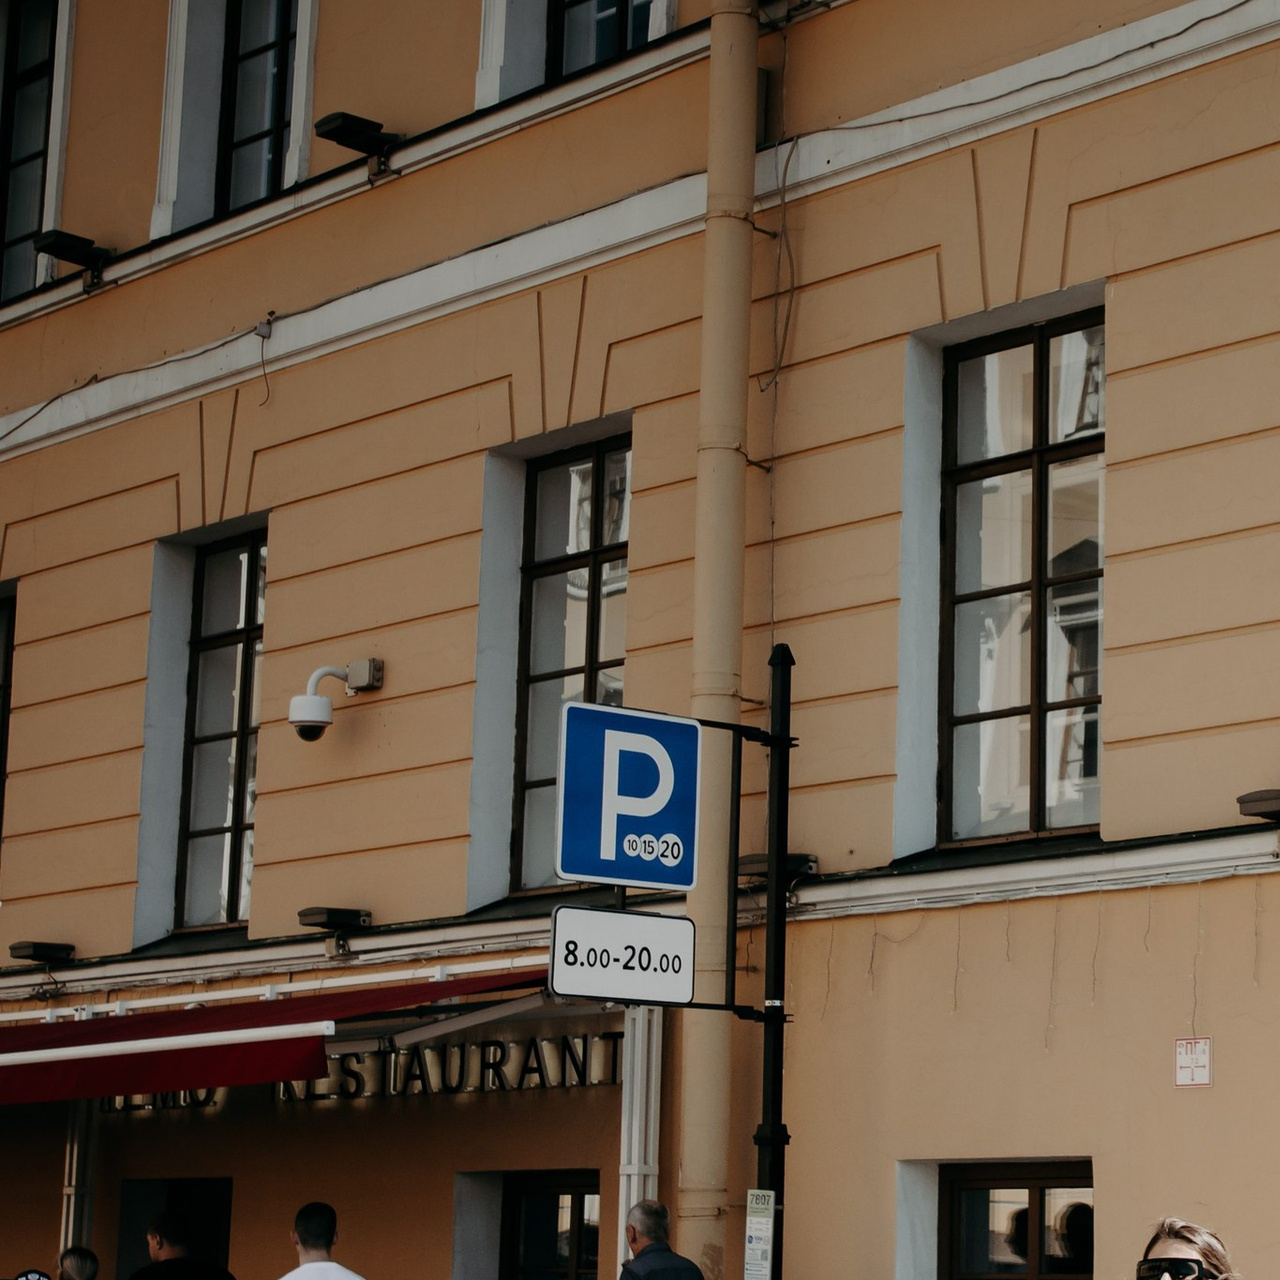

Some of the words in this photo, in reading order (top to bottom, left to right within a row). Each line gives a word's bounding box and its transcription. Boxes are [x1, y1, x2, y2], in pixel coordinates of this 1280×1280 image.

[600, 729, 675, 860] P
[627, 839, 638, 852] 10
[642, 840, 655, 855] 15
[660, 840, 681, 860] 20
[563, 940, 682, 974] 8.00-20.00
